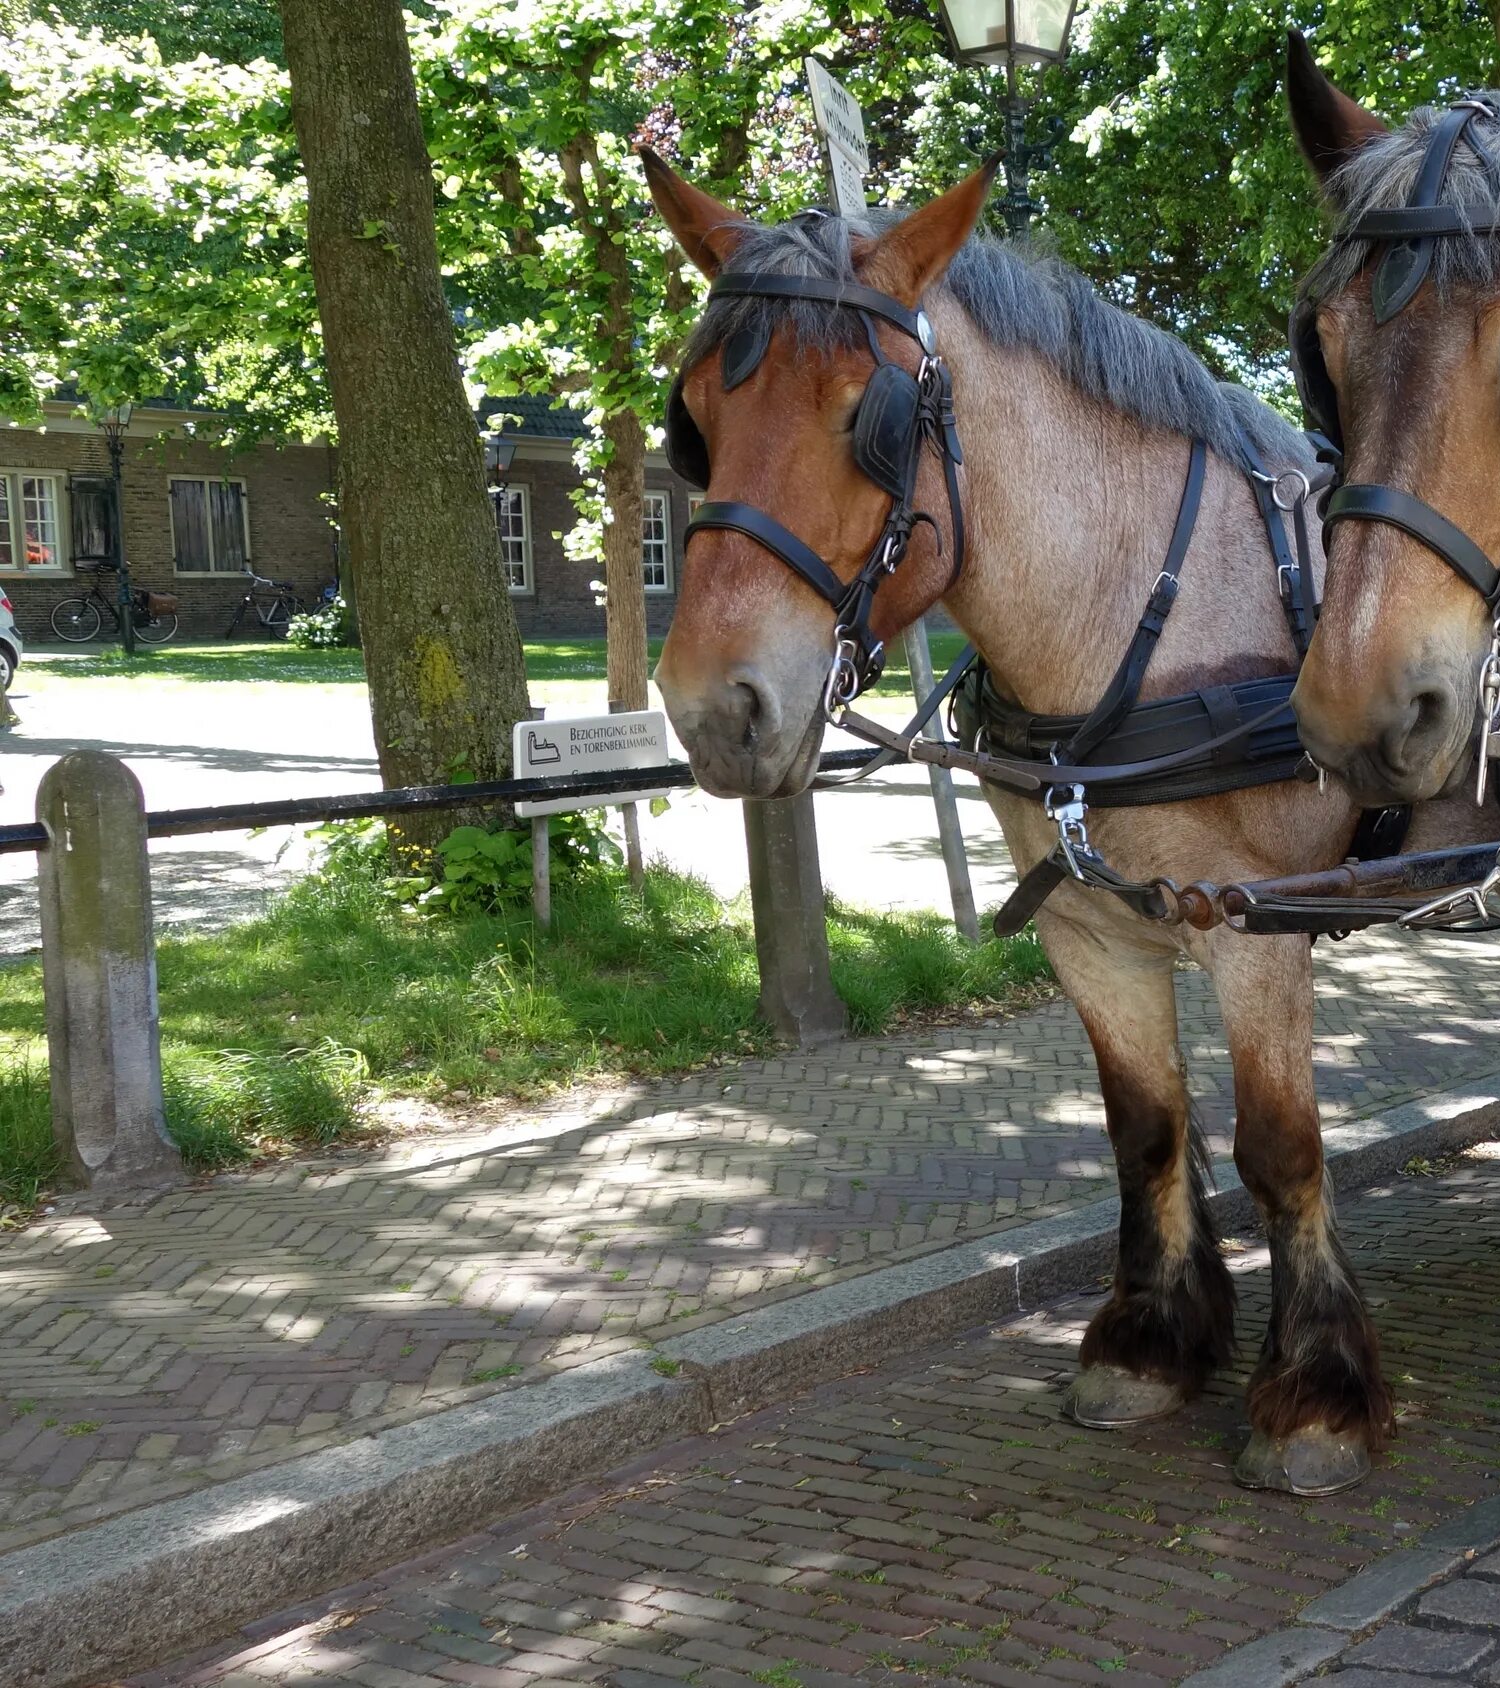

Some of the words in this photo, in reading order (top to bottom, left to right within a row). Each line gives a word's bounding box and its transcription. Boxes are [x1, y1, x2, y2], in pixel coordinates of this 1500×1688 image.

[570, 725, 627, 741] BEZICHTIGING
[629, 723, 648, 734] KERK
[570, 744, 581, 755] EN
[583, 736, 657, 754] TORENBEKLIMMING
